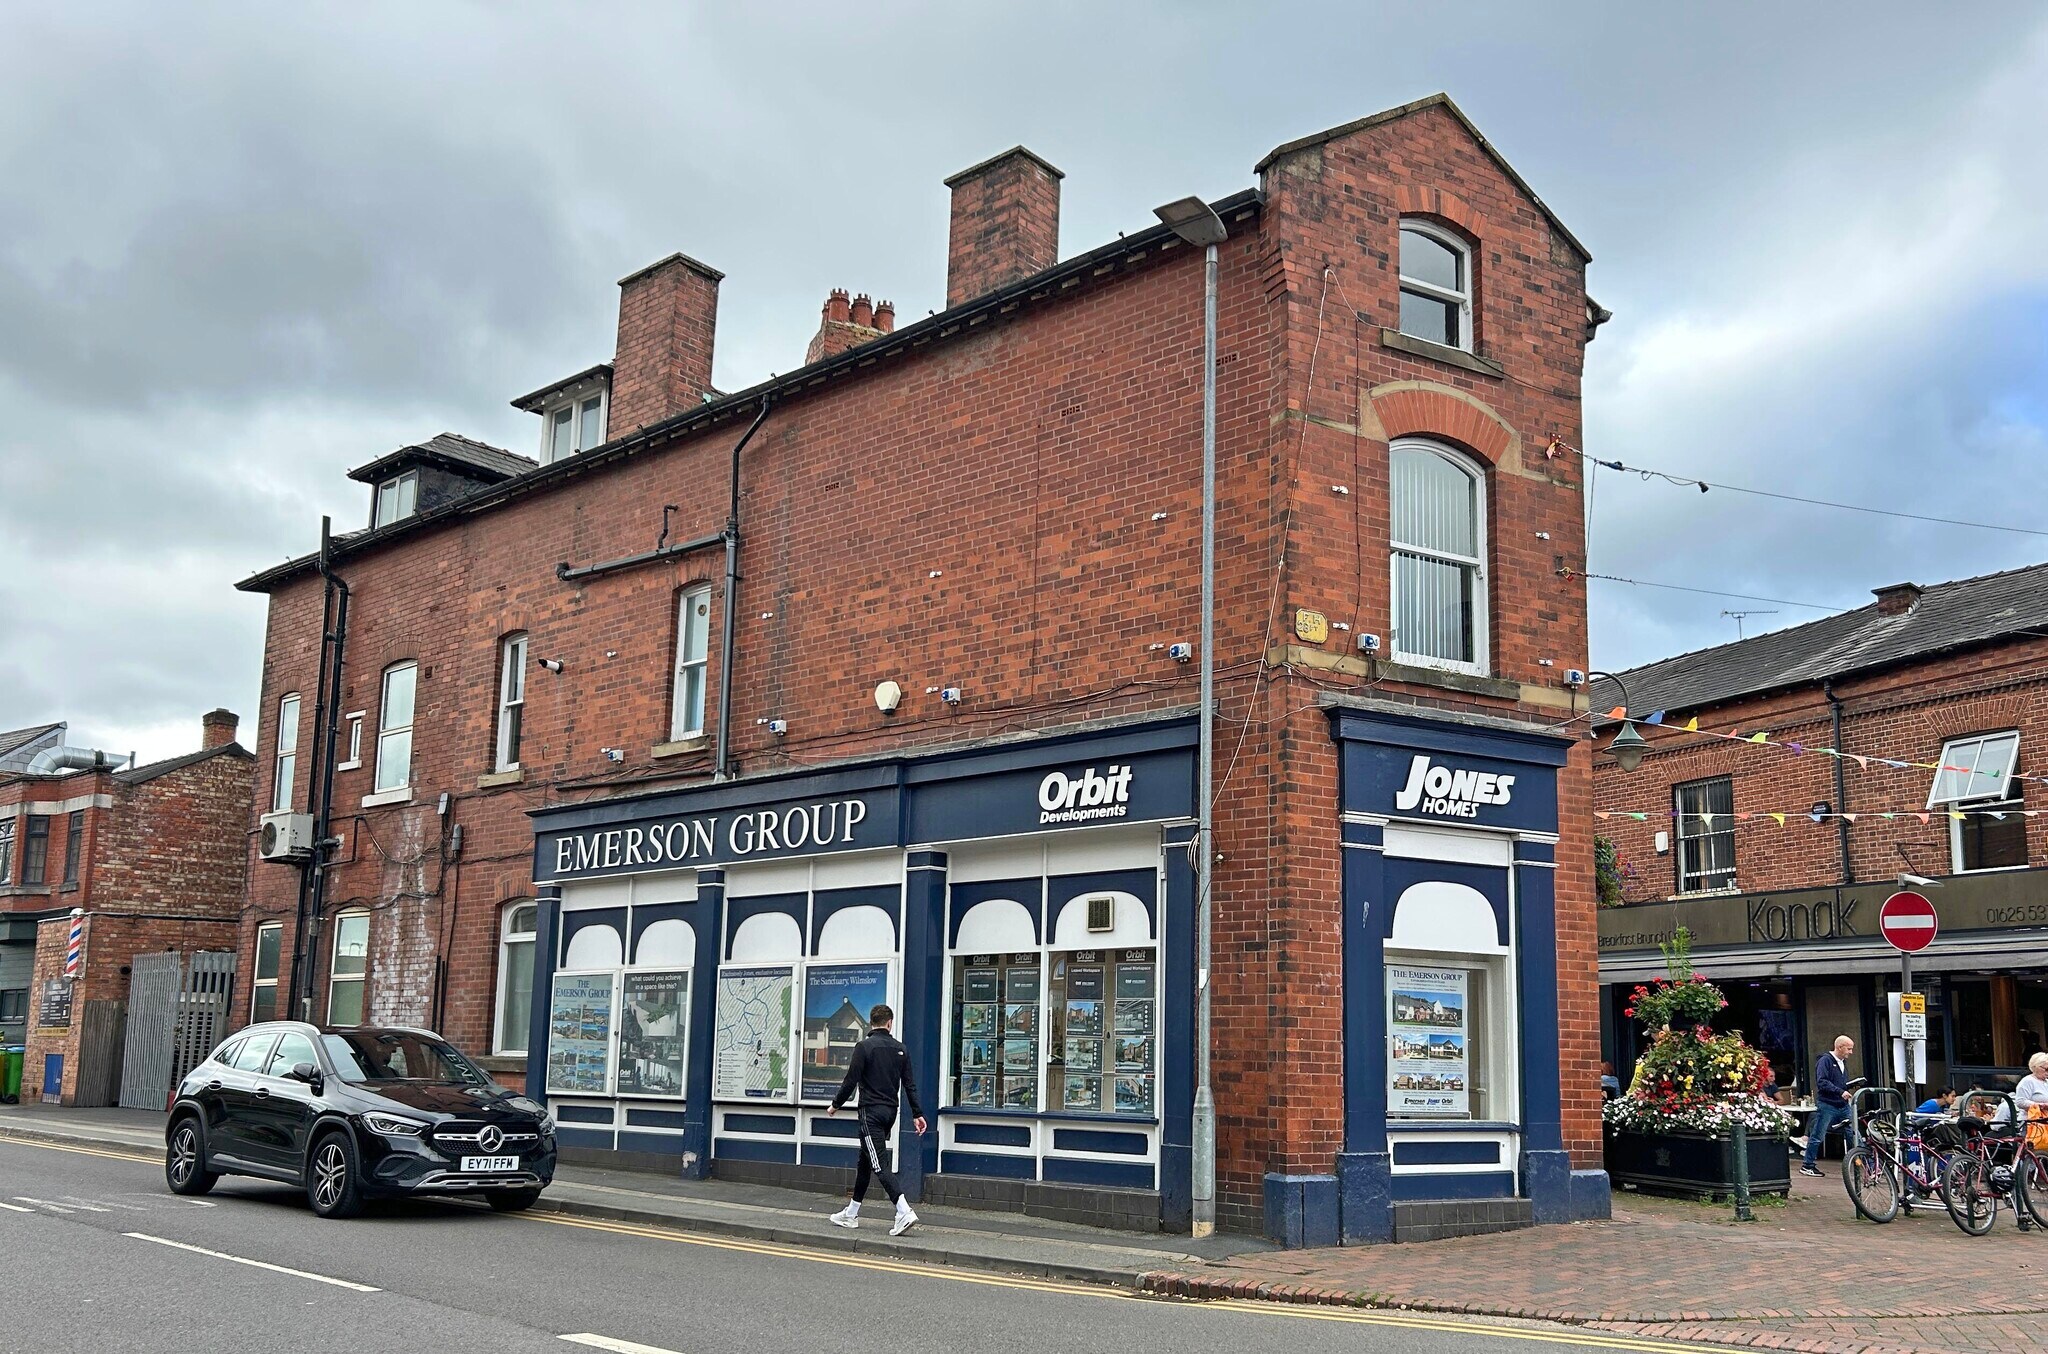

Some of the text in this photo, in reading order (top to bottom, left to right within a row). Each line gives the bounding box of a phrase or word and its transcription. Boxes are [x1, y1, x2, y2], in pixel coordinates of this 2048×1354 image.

[1038, 765, 1133, 811] Orbit
[1396, 755, 1516, 810] JONES
[1039, 804, 1127, 824] Developments
[1421, 797, 1480, 818] HOMES
[554, 799, 867, 874] EMERSON GROUP
[1747, 888, 1857, 942] Konak
[1986, 904, 2048, 923] 01625 53
[1598, 932, 1635, 947] Breakfast
[1636, 930, 1668, 945] Brunch
[577, 979, 590, 988] THE
[810, 977, 820, 985] The
[850, 976, 878, 985] Wilmslow
[1392, 970, 1463, 981] THE EMERSON GROUP
[555, 988, 612, 999] EMERSON GROUP
[468, 1158, 513, 1169] EY71 FFM
